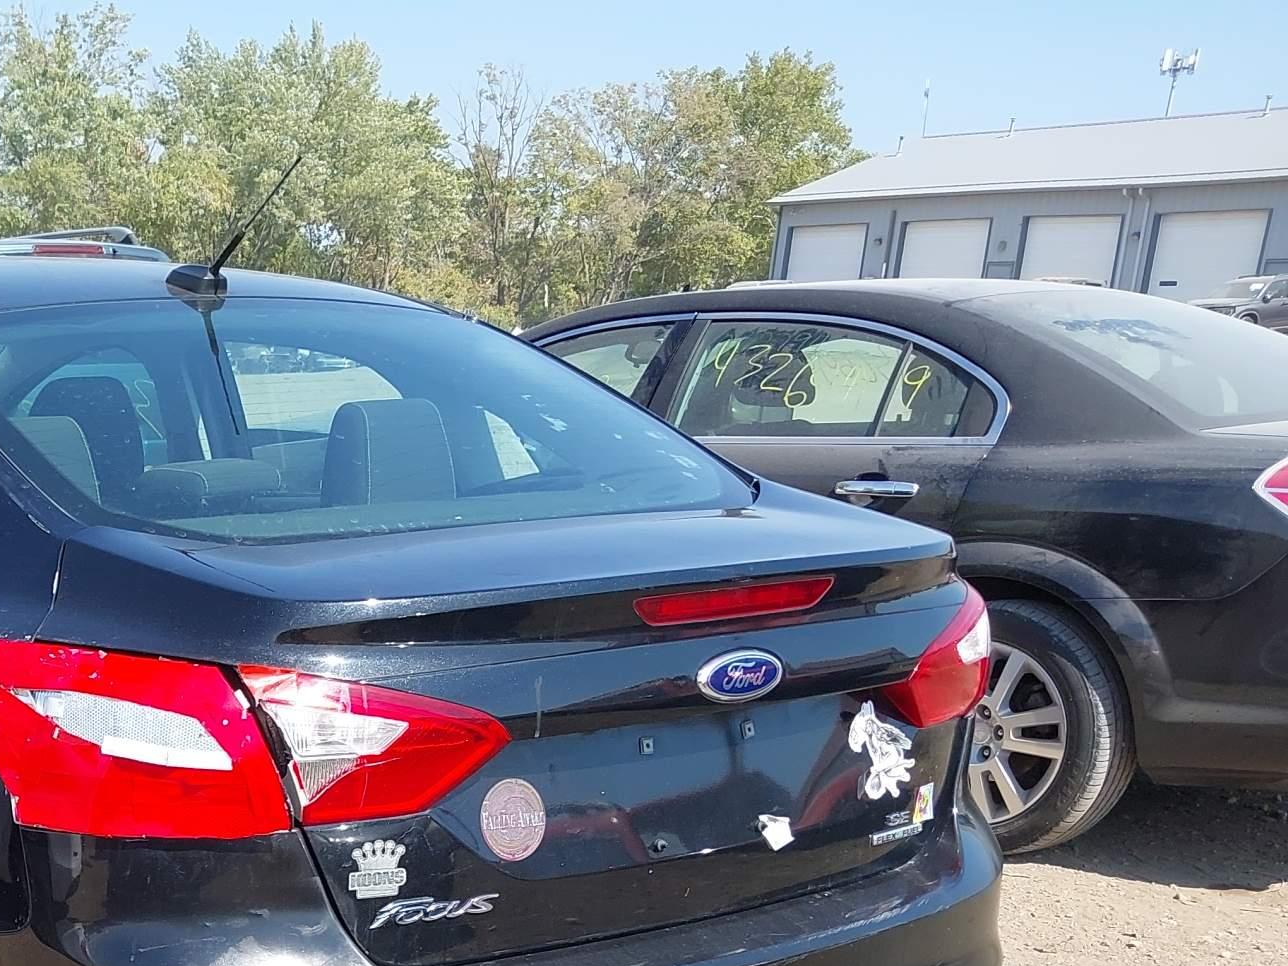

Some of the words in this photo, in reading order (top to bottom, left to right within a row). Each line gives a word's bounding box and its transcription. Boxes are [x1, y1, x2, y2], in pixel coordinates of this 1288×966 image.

[722, 661, 767, 690] Ford
[883, 810, 911, 827] SE
[876, 831, 897, 844] FLEX
[902, 825, 922, 839] FUEL
